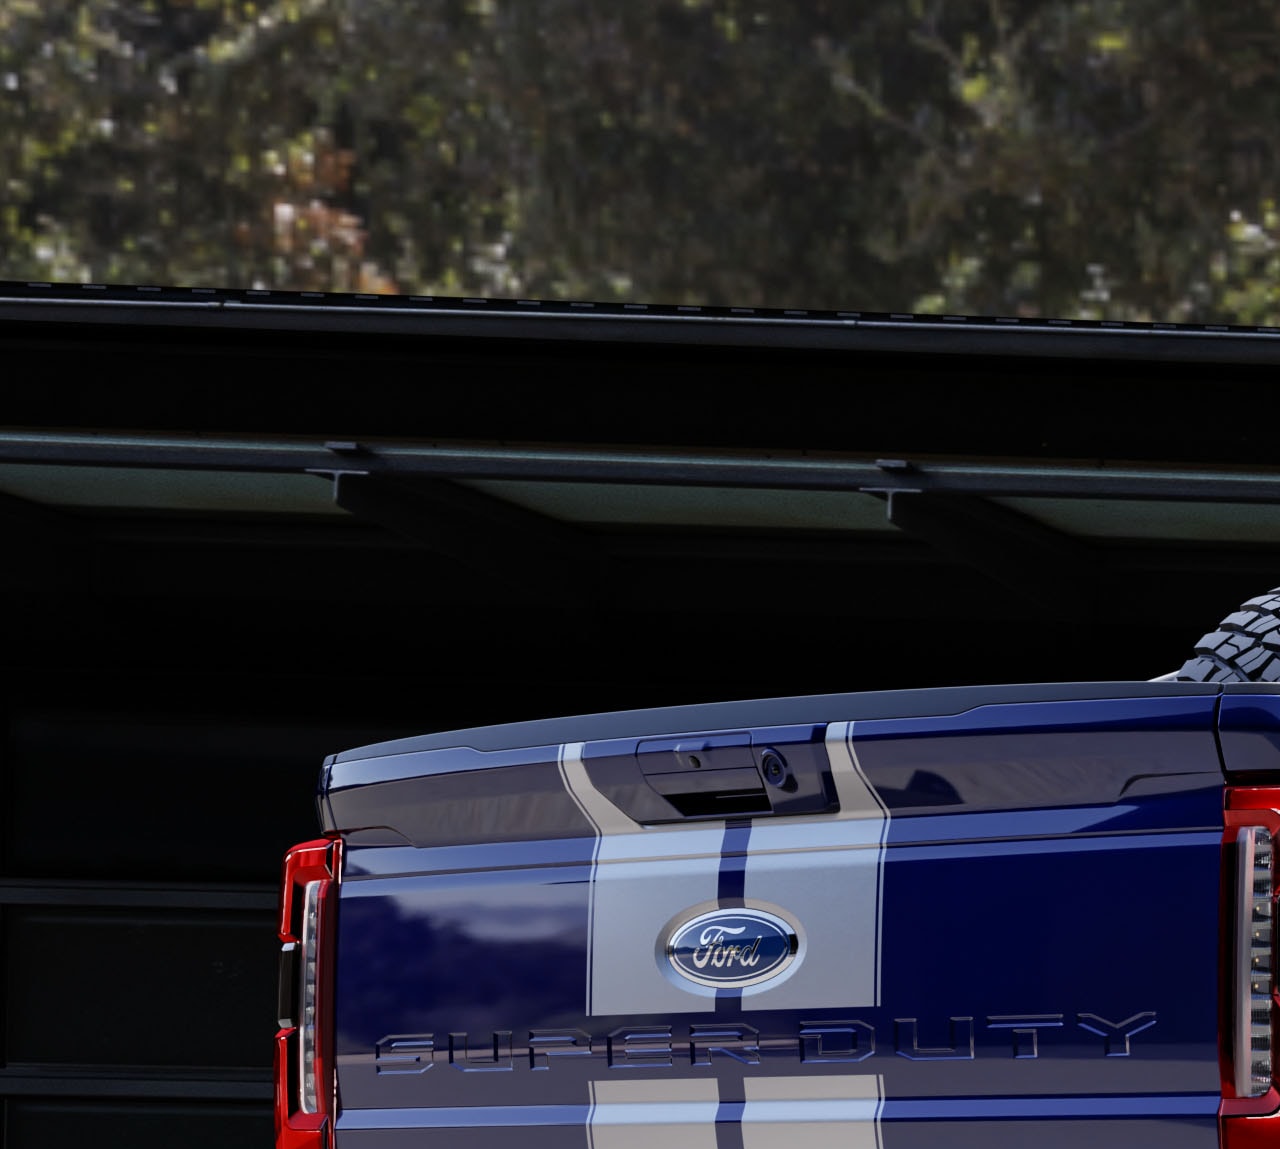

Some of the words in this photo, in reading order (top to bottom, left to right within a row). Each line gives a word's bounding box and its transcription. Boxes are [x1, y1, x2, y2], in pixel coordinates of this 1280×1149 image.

[692, 925, 763, 969] Ford
[375, 1022, 761, 1076] SUPER
[800, 1010, 1157, 1063] DUTY
